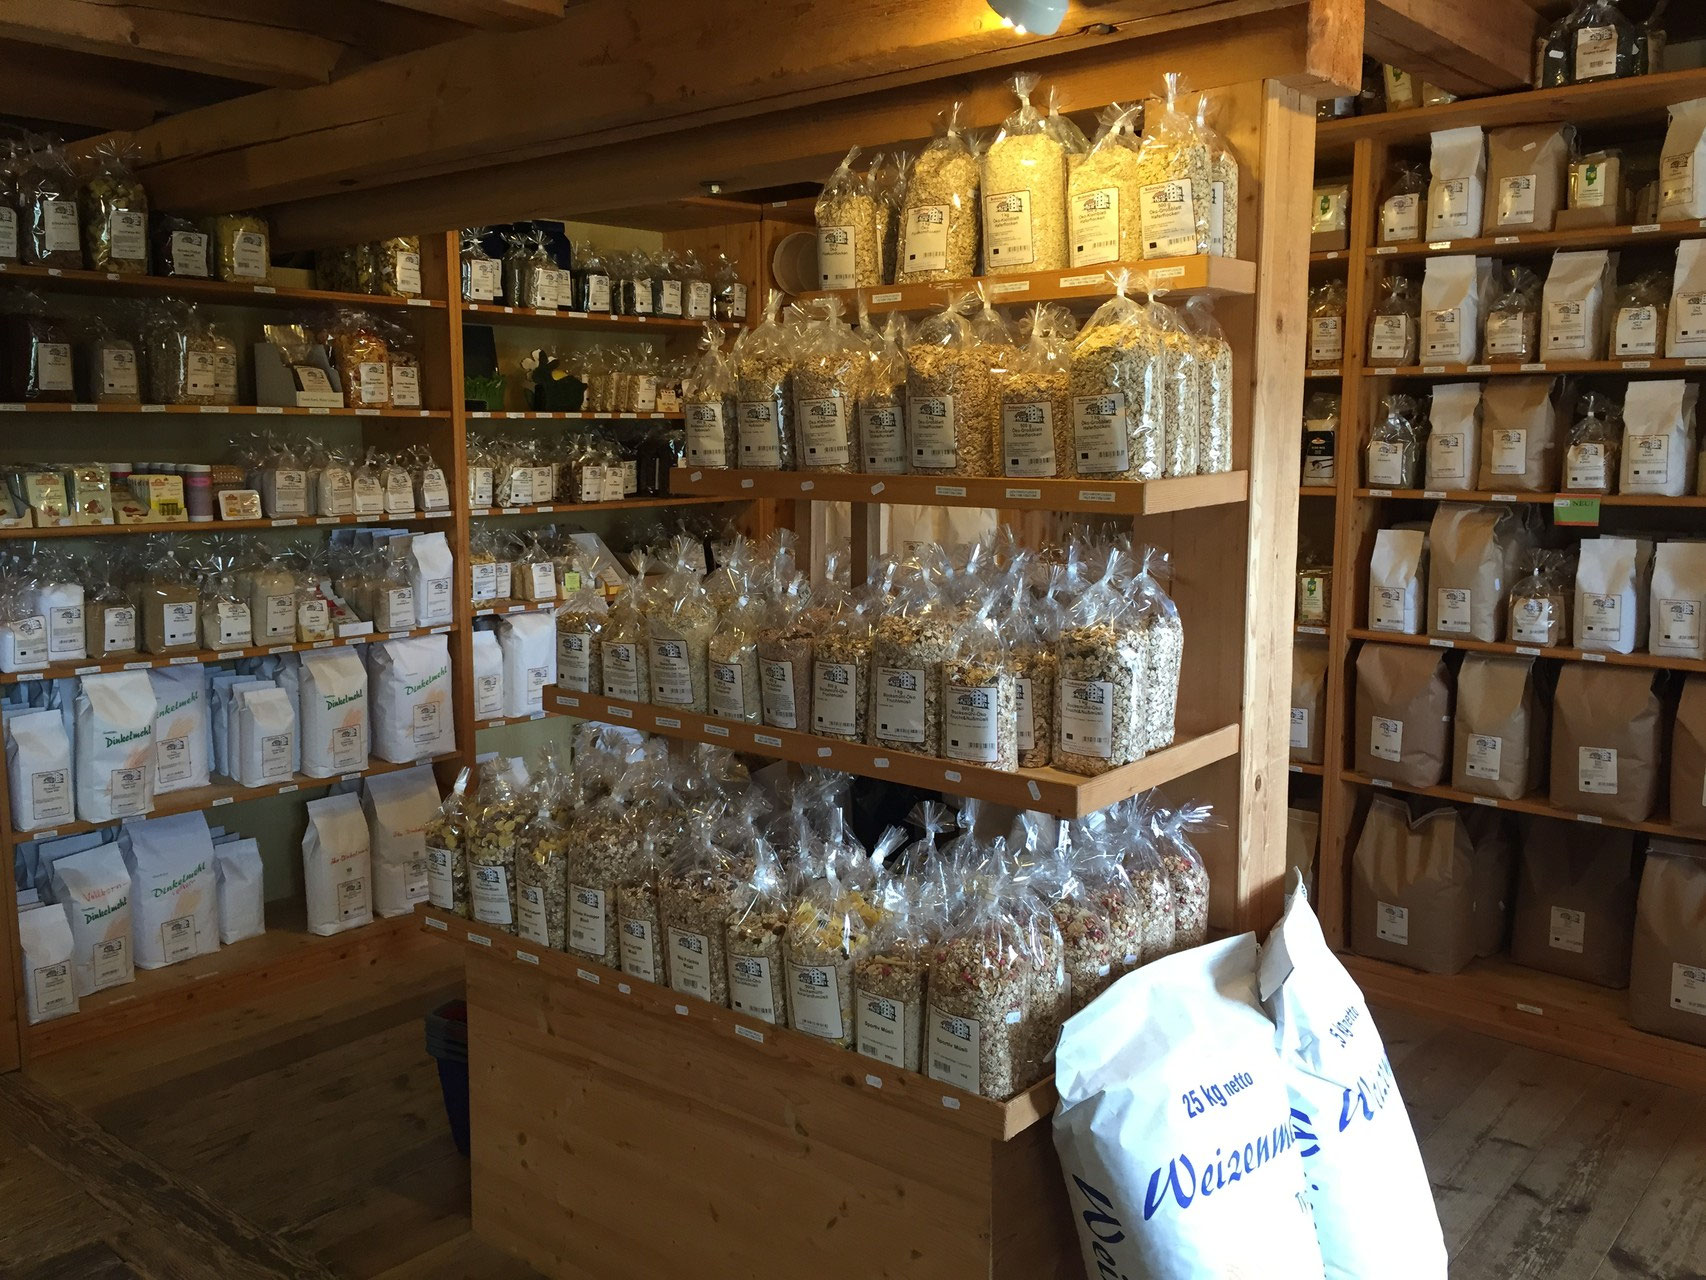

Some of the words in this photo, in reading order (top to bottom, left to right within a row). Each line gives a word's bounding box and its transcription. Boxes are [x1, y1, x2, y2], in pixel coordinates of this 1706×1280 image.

[404, 666, 448, 696] Dinkelmehl
[156, 691, 199, 719] inkelmehl
[326, 689, 363, 711] Dinkelmehl
[105, 724, 152, 748] Dinkelmehl
[152, 862, 206, 898] Dinkelmehl
[84, 897, 127, 925] Dinkelmehl
[1342, 1006, 1360, 1027] netto
[1182, 1089, 1205, 1119] 25
[1200, 1084, 1228, 1107] kg
[1223, 1072, 1254, 1097] netto
[1072, 1173, 1128, 1280] Wei
